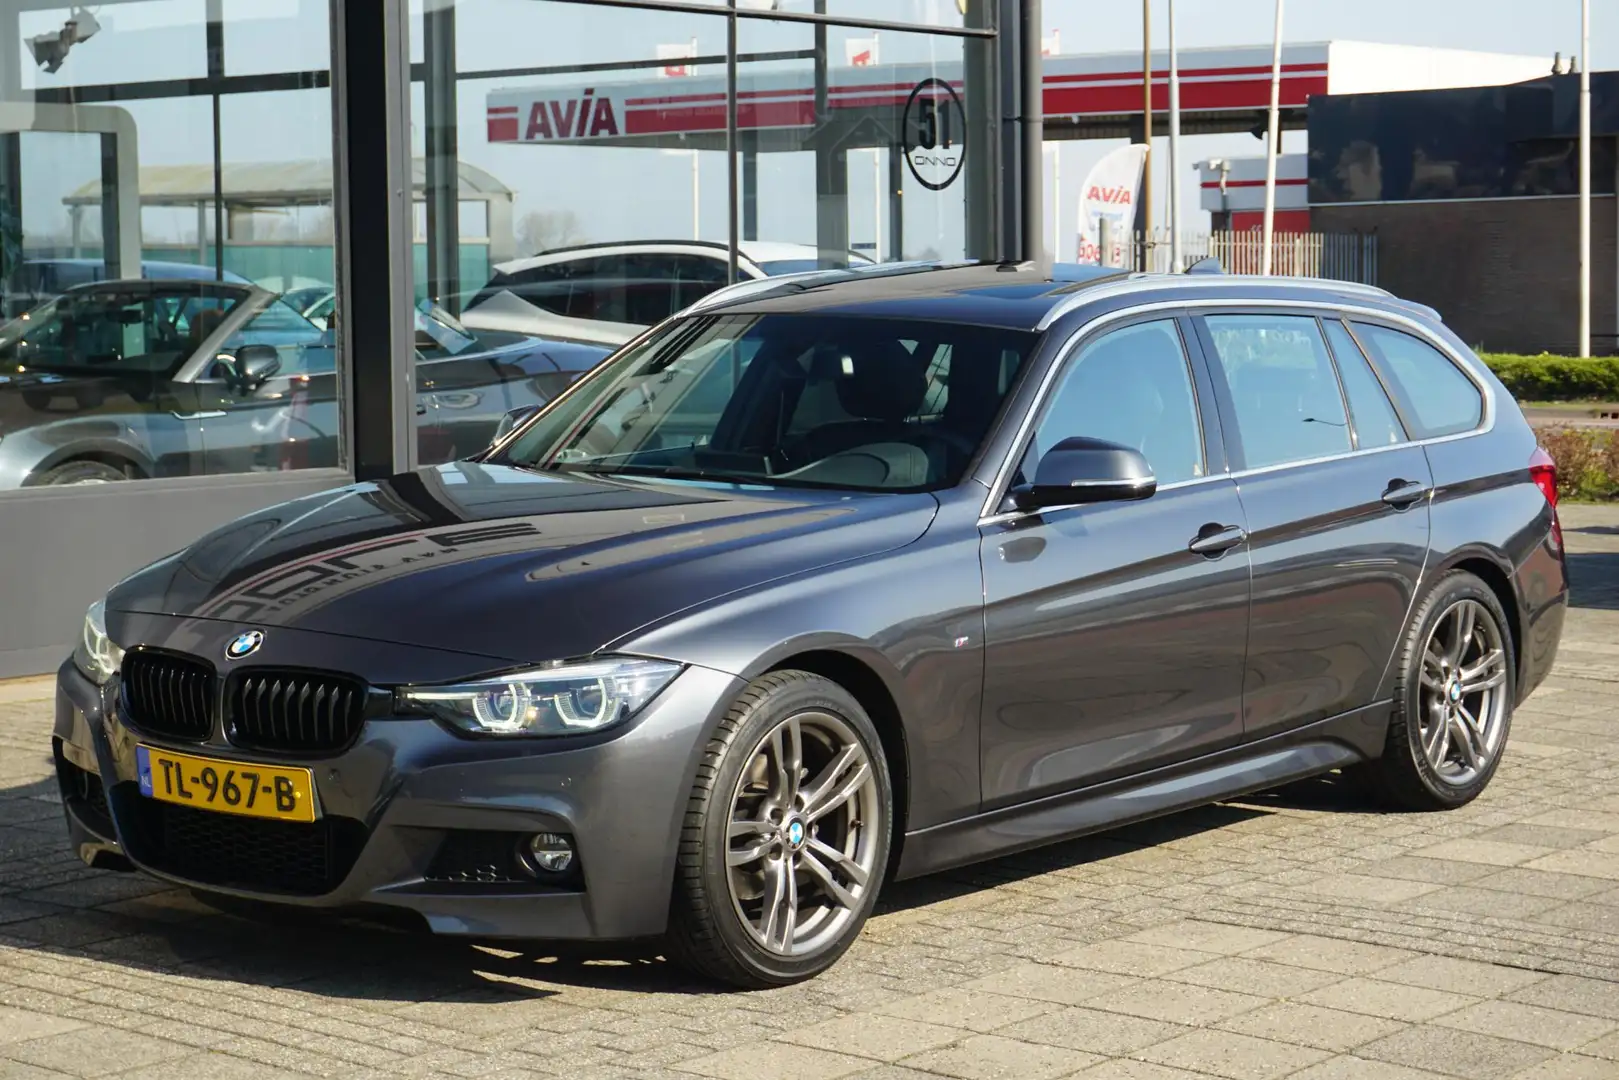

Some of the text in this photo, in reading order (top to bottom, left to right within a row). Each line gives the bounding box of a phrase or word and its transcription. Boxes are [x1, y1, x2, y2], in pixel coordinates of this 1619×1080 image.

[918, 98, 950, 149] 51
[1087, 185, 1131, 204] AVIA
[158, 758, 296, 812] TL-967-B
